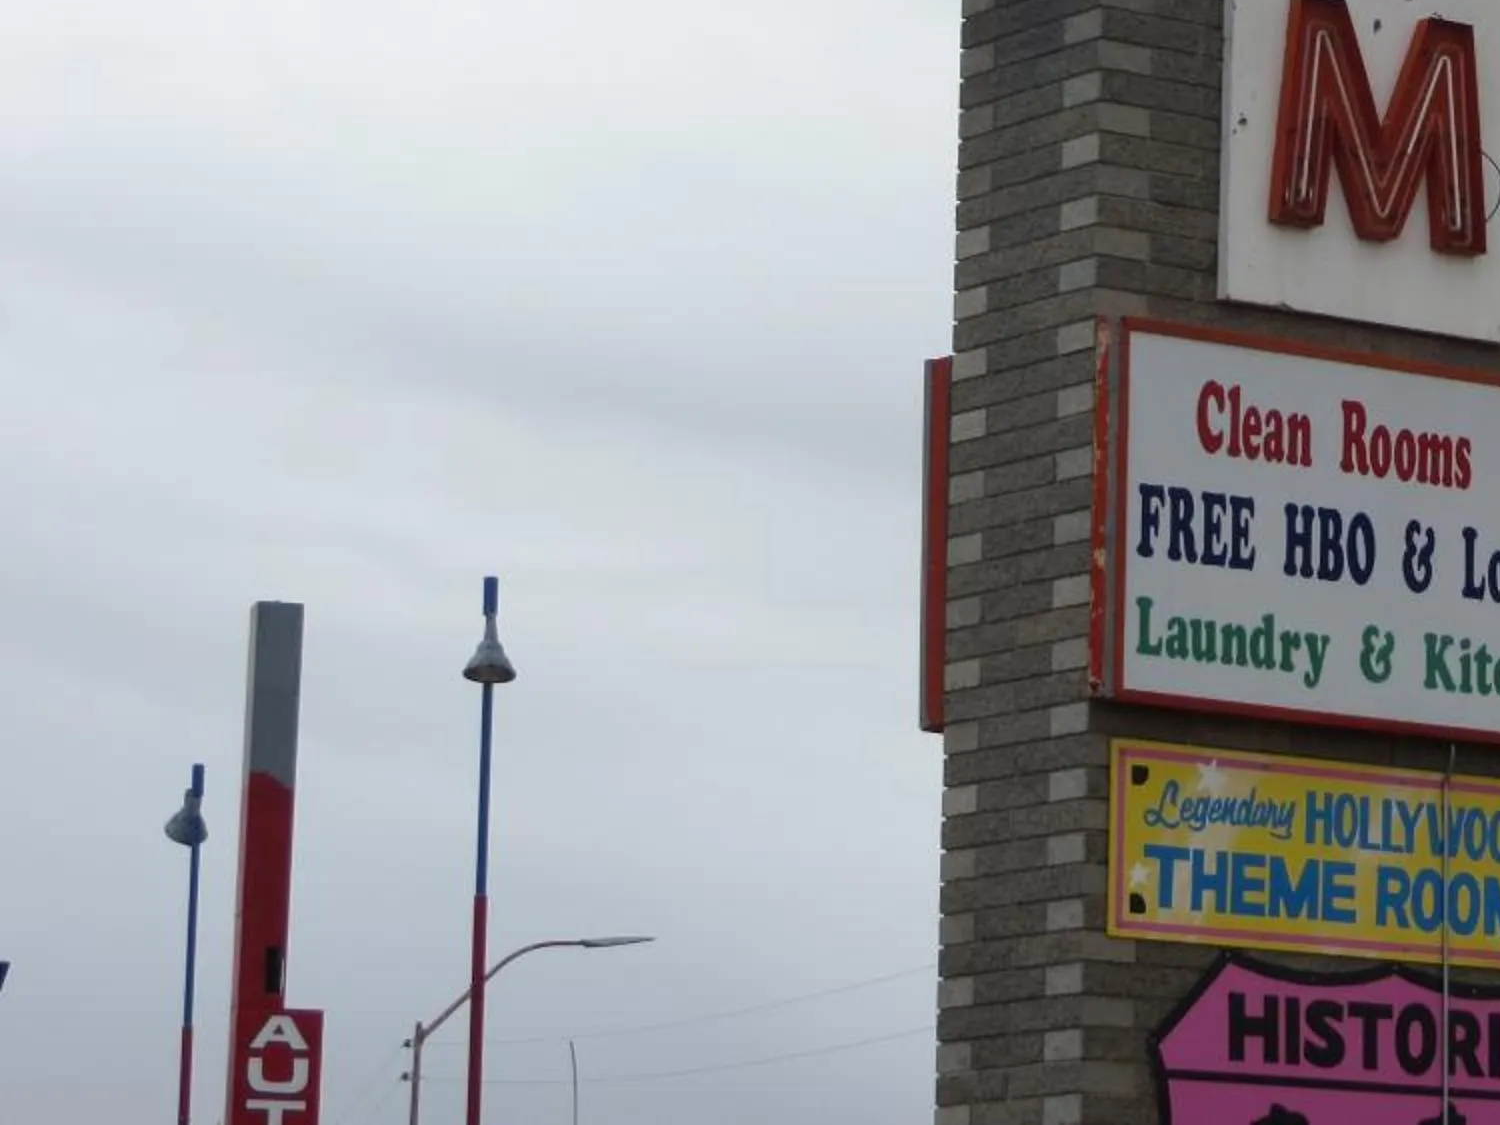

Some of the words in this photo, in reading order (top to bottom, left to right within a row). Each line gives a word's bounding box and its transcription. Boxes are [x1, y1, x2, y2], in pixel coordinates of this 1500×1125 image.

[1197, 379, 1313, 468] Clean
[1340, 399, 1472, 490] Rooms
[1136, 483, 1256, 571] FREE
[1283, 502, 1376, 585] HBO
[1402, 519, 1436, 594] &
[1136, 597, 1331, 689] Laundry
[1359, 625, 1396, 684] &
[1143, 779, 1295, 839] Legendary
[1143, 843, 1357, 925] THEME
